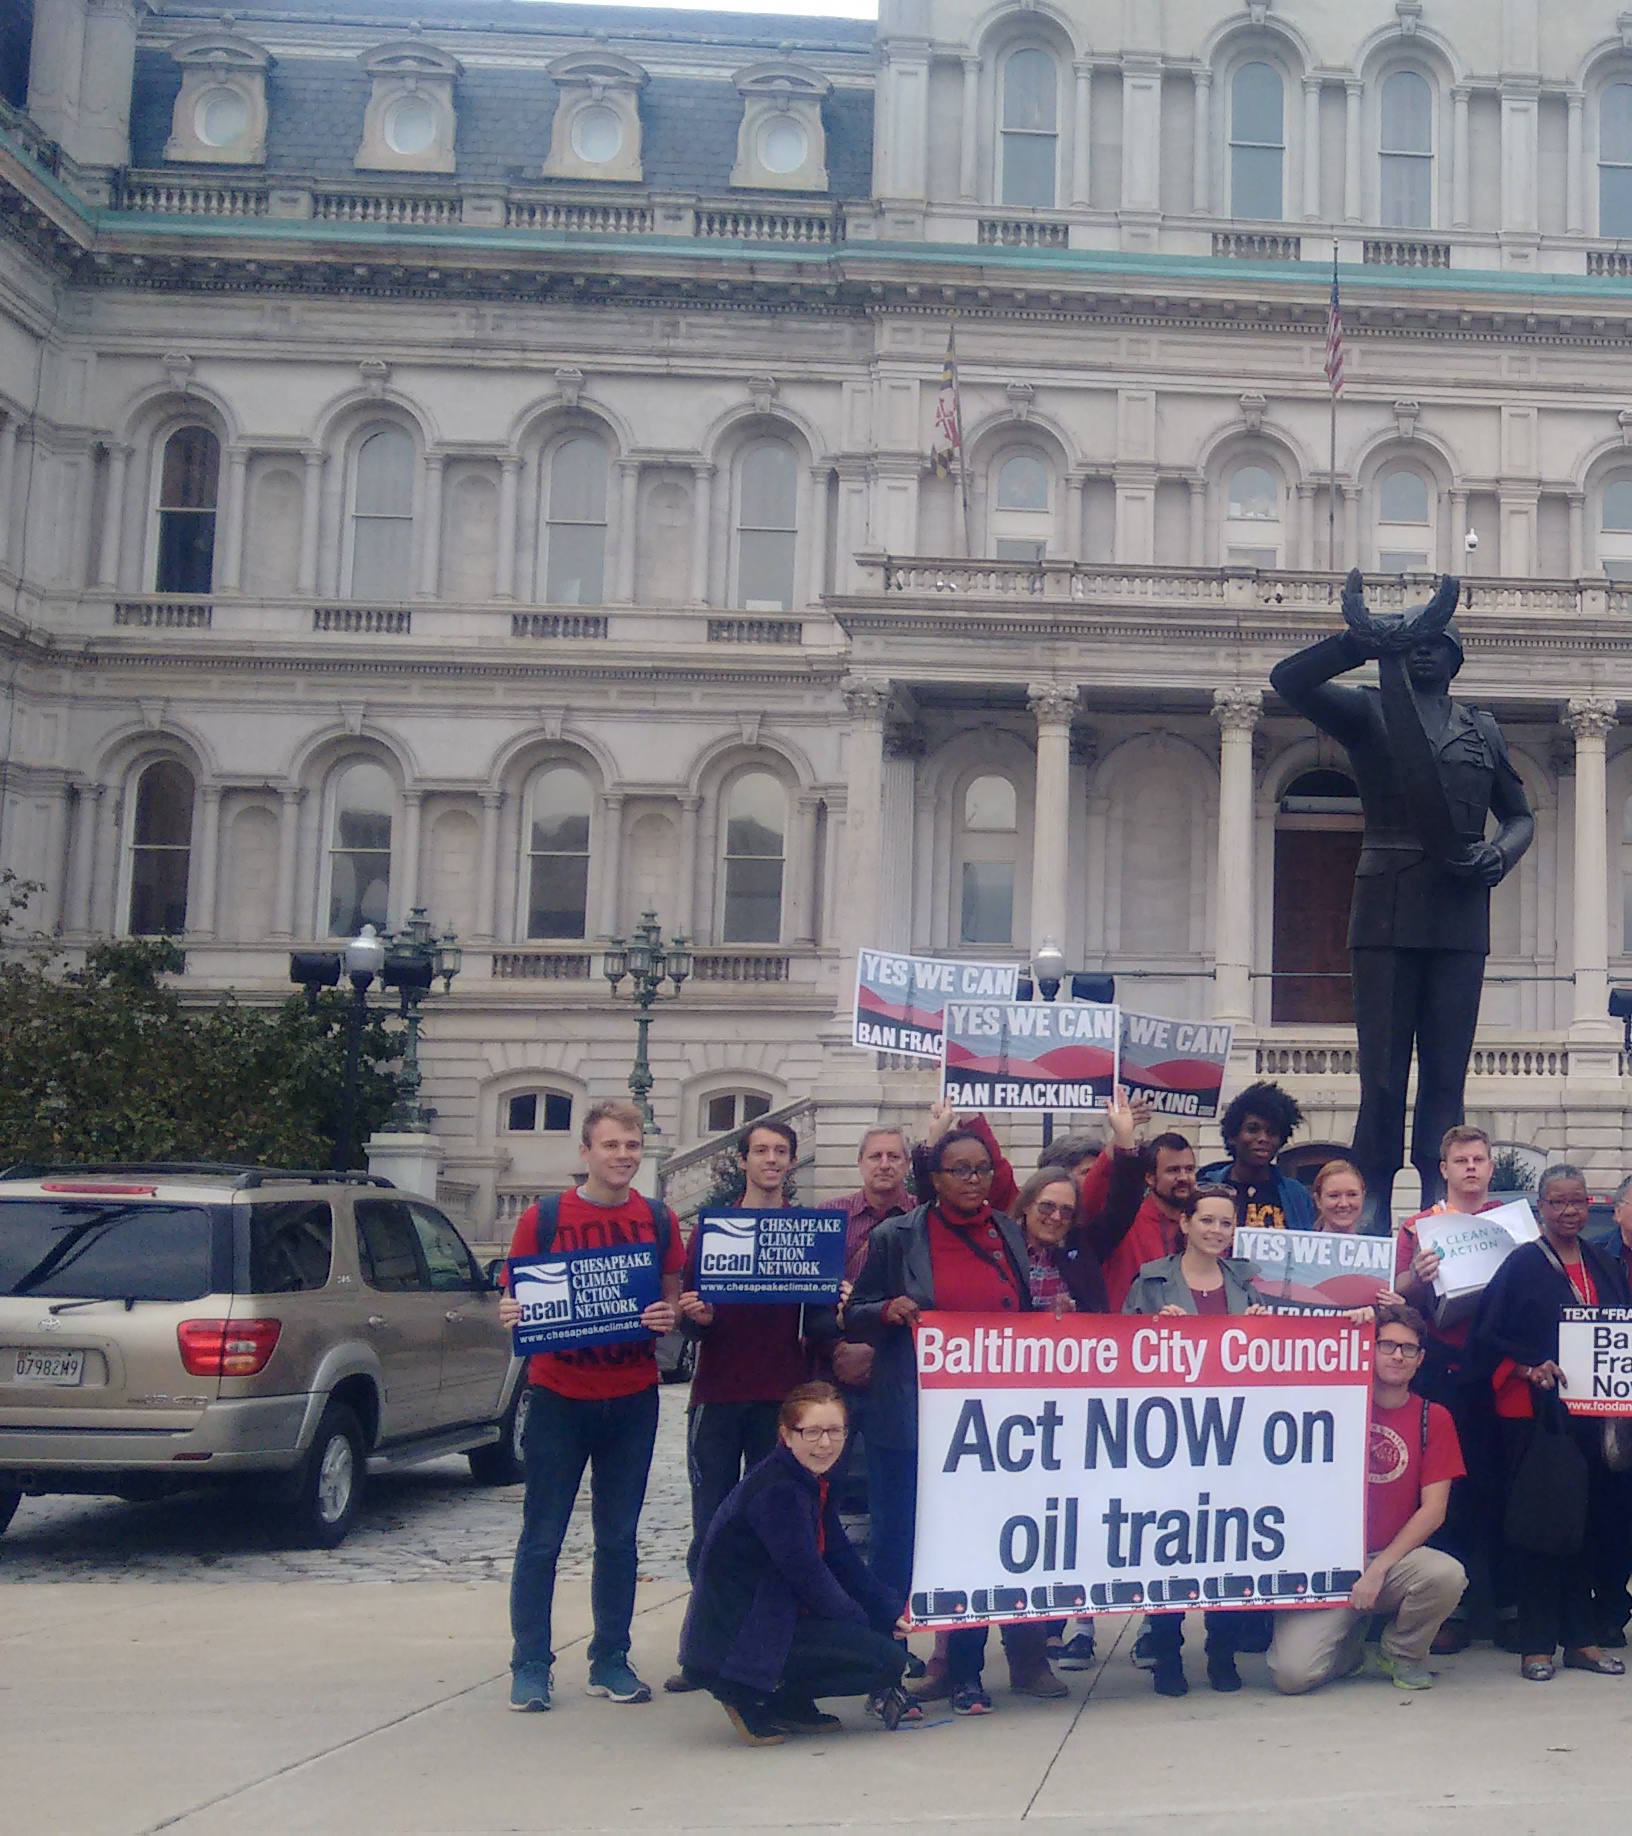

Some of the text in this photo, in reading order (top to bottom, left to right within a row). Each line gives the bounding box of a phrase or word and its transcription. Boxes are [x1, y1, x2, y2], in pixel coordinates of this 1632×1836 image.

[864, 954, 1013, 996] YES WE CAN
[951, 1005, 1001, 1035] YES
[1006, 1006, 1050, 1038] WE
[1058, 1008, 1115, 1039] CAN
[859, 1022, 896, 1047] BAN
[1129, 1016, 1171, 1049] WE
[1176, 1025, 1229, 1054] CAN
[946, 1082, 990, 1106] BAN
[994, 1083, 1092, 1107] FRACKING
[760, 1218, 842, 1233] CHESAPEAKE
[1446, 1228, 1488, 1245] CLEAN
[759, 1233, 815, 1247] CLIMATE
[1240, 1232, 1391, 1269] YES WE CAN
[1450, 1239, 1498, 1258] ACTION
[570, 1251, 652, 1275] CHESAPEAKE
[703, 1253, 751, 1272] ccan
[758, 1248, 805, 1261] ACTION
[757, 1261, 821, 1275] NETWORK
[572, 1270, 629, 1290] CLIMATE
[700, 1282, 837, 1293] www.chesapeakeclimate.org
[574, 1285, 621, 1305] ACTION
[520, 1299, 569, 1323] ccan
[575, 1298, 639, 1320] NETWORK
[1563, 1308, 1599, 1320] TEXT
[917, 1327, 1370, 1383] Baltimore City Council:
[941, 1398, 1064, 1473] Act
[1083, 1396, 1246, 1470] NOW
[1262, 1408, 1334, 1466] on
[999, 1491, 1286, 1575] oil trains
